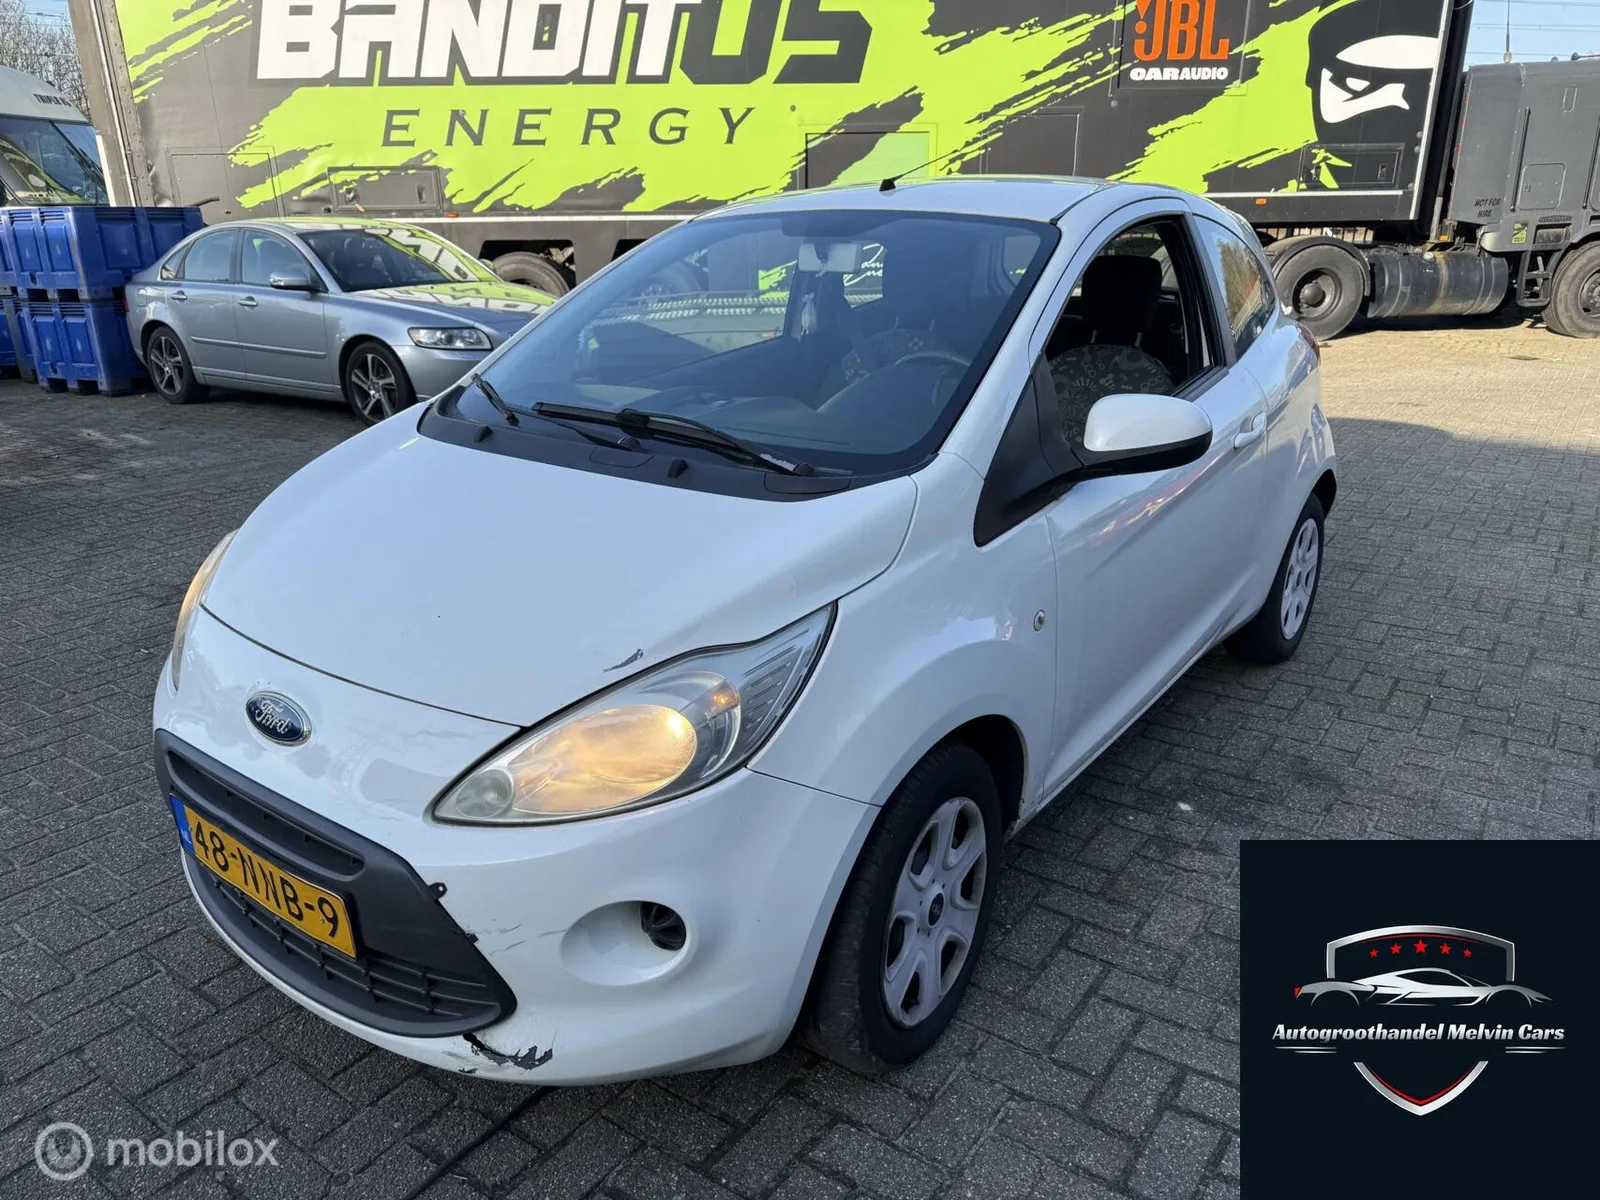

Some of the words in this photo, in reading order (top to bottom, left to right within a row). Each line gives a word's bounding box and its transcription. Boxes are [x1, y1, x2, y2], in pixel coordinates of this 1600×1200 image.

[1134, 0, 1230, 61] JBL
[381, 107, 755, 147] ENERGY
[255, 700, 292, 734] Ford
[195, 821, 339, 938] 48-NNB-9
